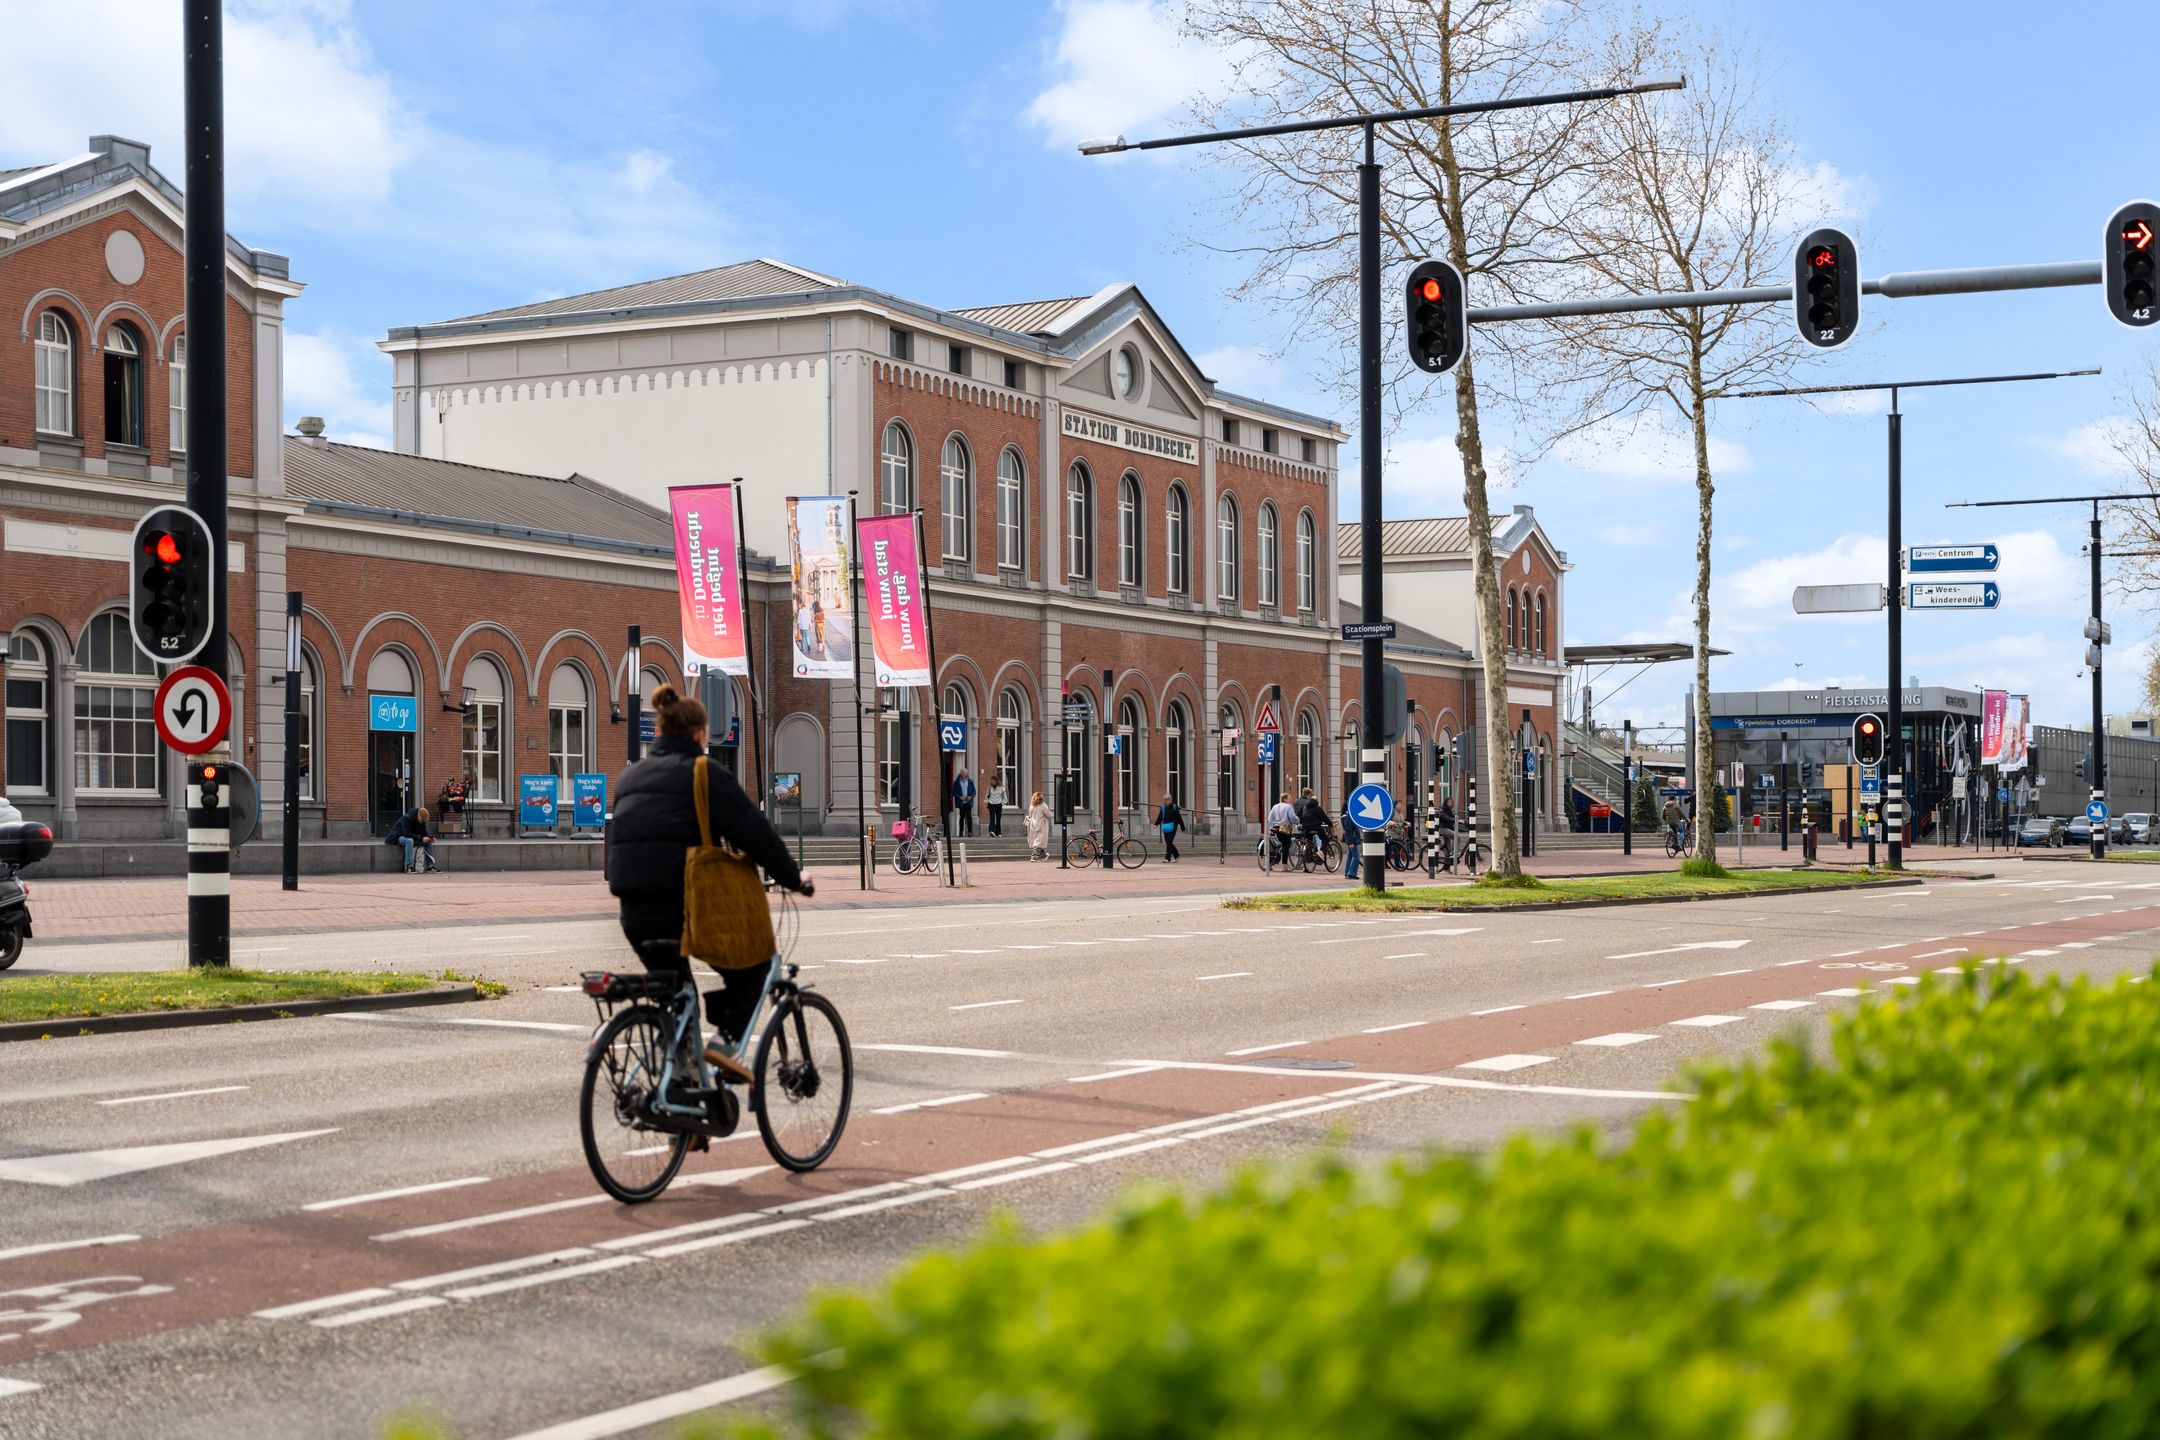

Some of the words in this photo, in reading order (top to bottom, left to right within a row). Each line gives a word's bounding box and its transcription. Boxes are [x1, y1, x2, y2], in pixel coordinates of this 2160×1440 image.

[2132, 308, 2150, 319] 4.2
[1820, 329, 1835, 340] 22
[1428, 356, 1442, 367] 5.1
[1064, 413, 1118, 442] STATION
[1938, 549, 1974, 557] Centrum
[1930, 595, 1984, 605] kinderendijk
[1344, 624, 1393, 634] Stationsplein
[160, 637, 179, 649] 5.2
[1825, 694, 1921, 707] FIETSENSTAING
[1267, 734, 1273, 748] P
